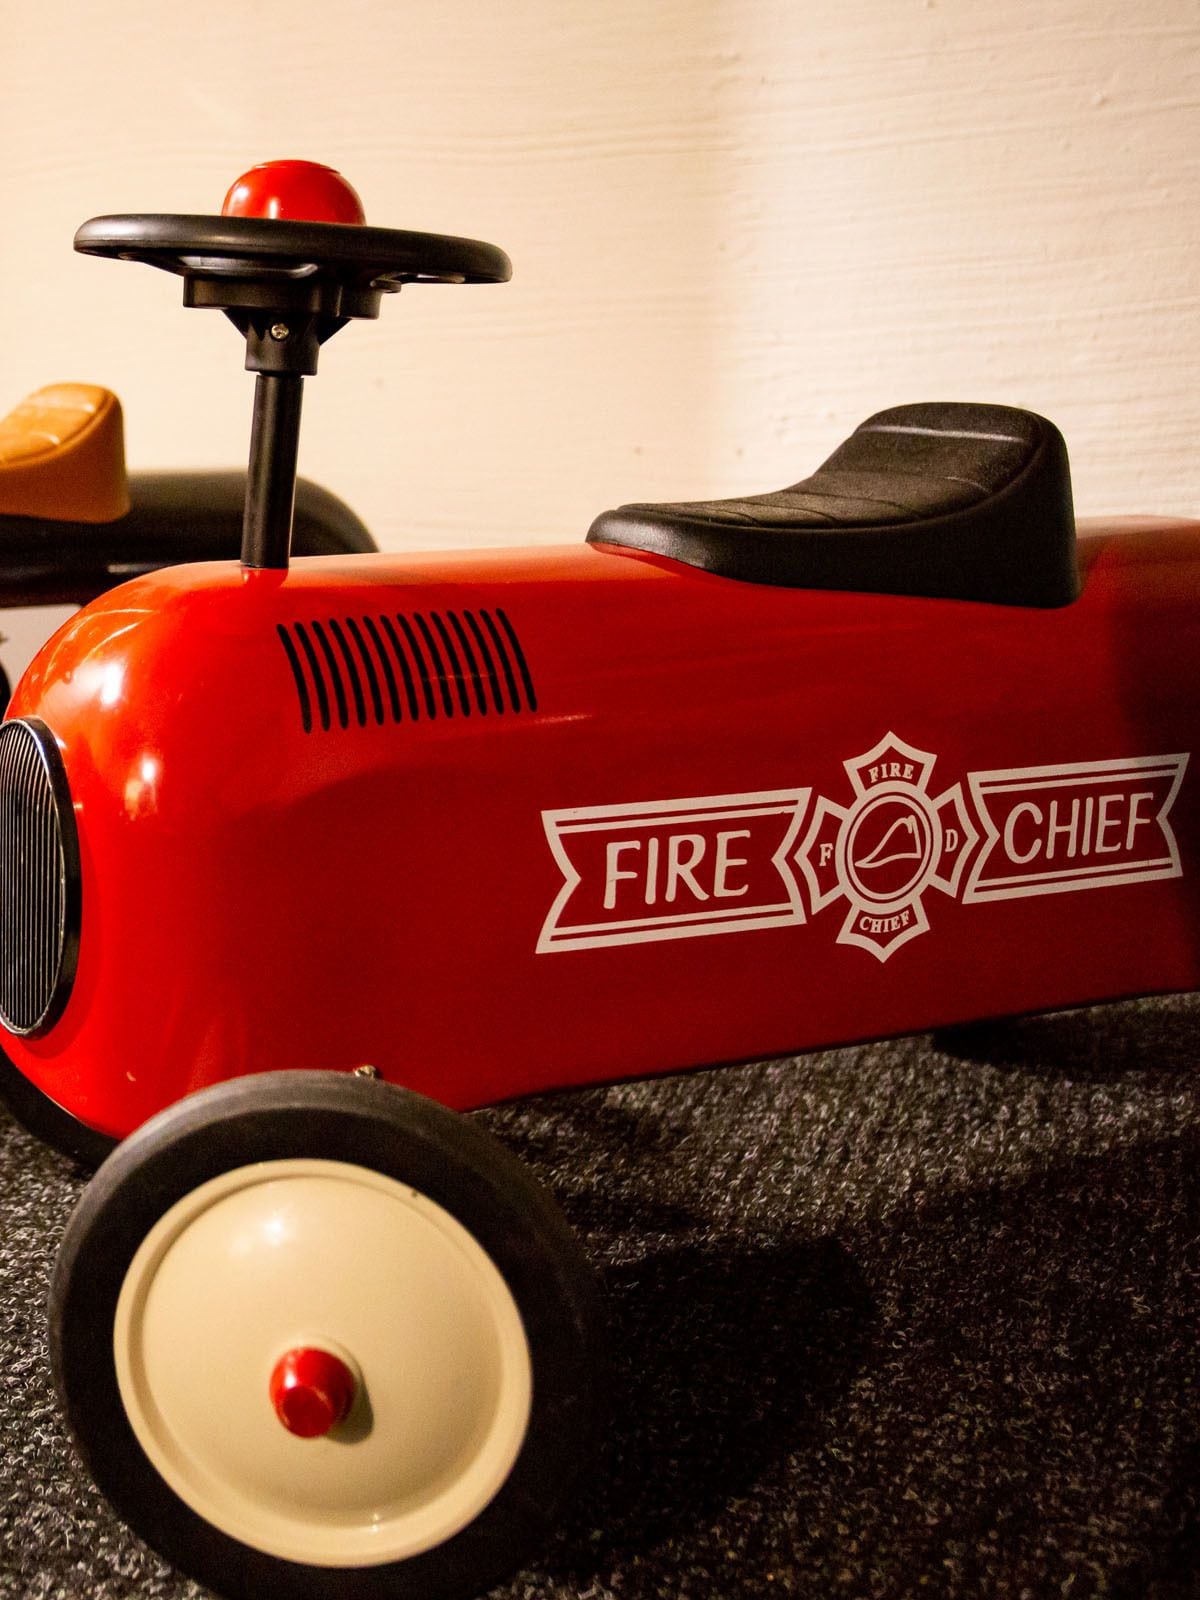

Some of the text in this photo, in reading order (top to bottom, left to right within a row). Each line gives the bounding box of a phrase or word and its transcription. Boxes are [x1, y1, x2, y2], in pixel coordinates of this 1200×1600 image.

[869, 762, 914, 783] FIRE
[603, 792, 1154, 909] FIRE CHIEF
[819, 828, 958, 866] F D
[859, 910, 911, 933] CHIEF
